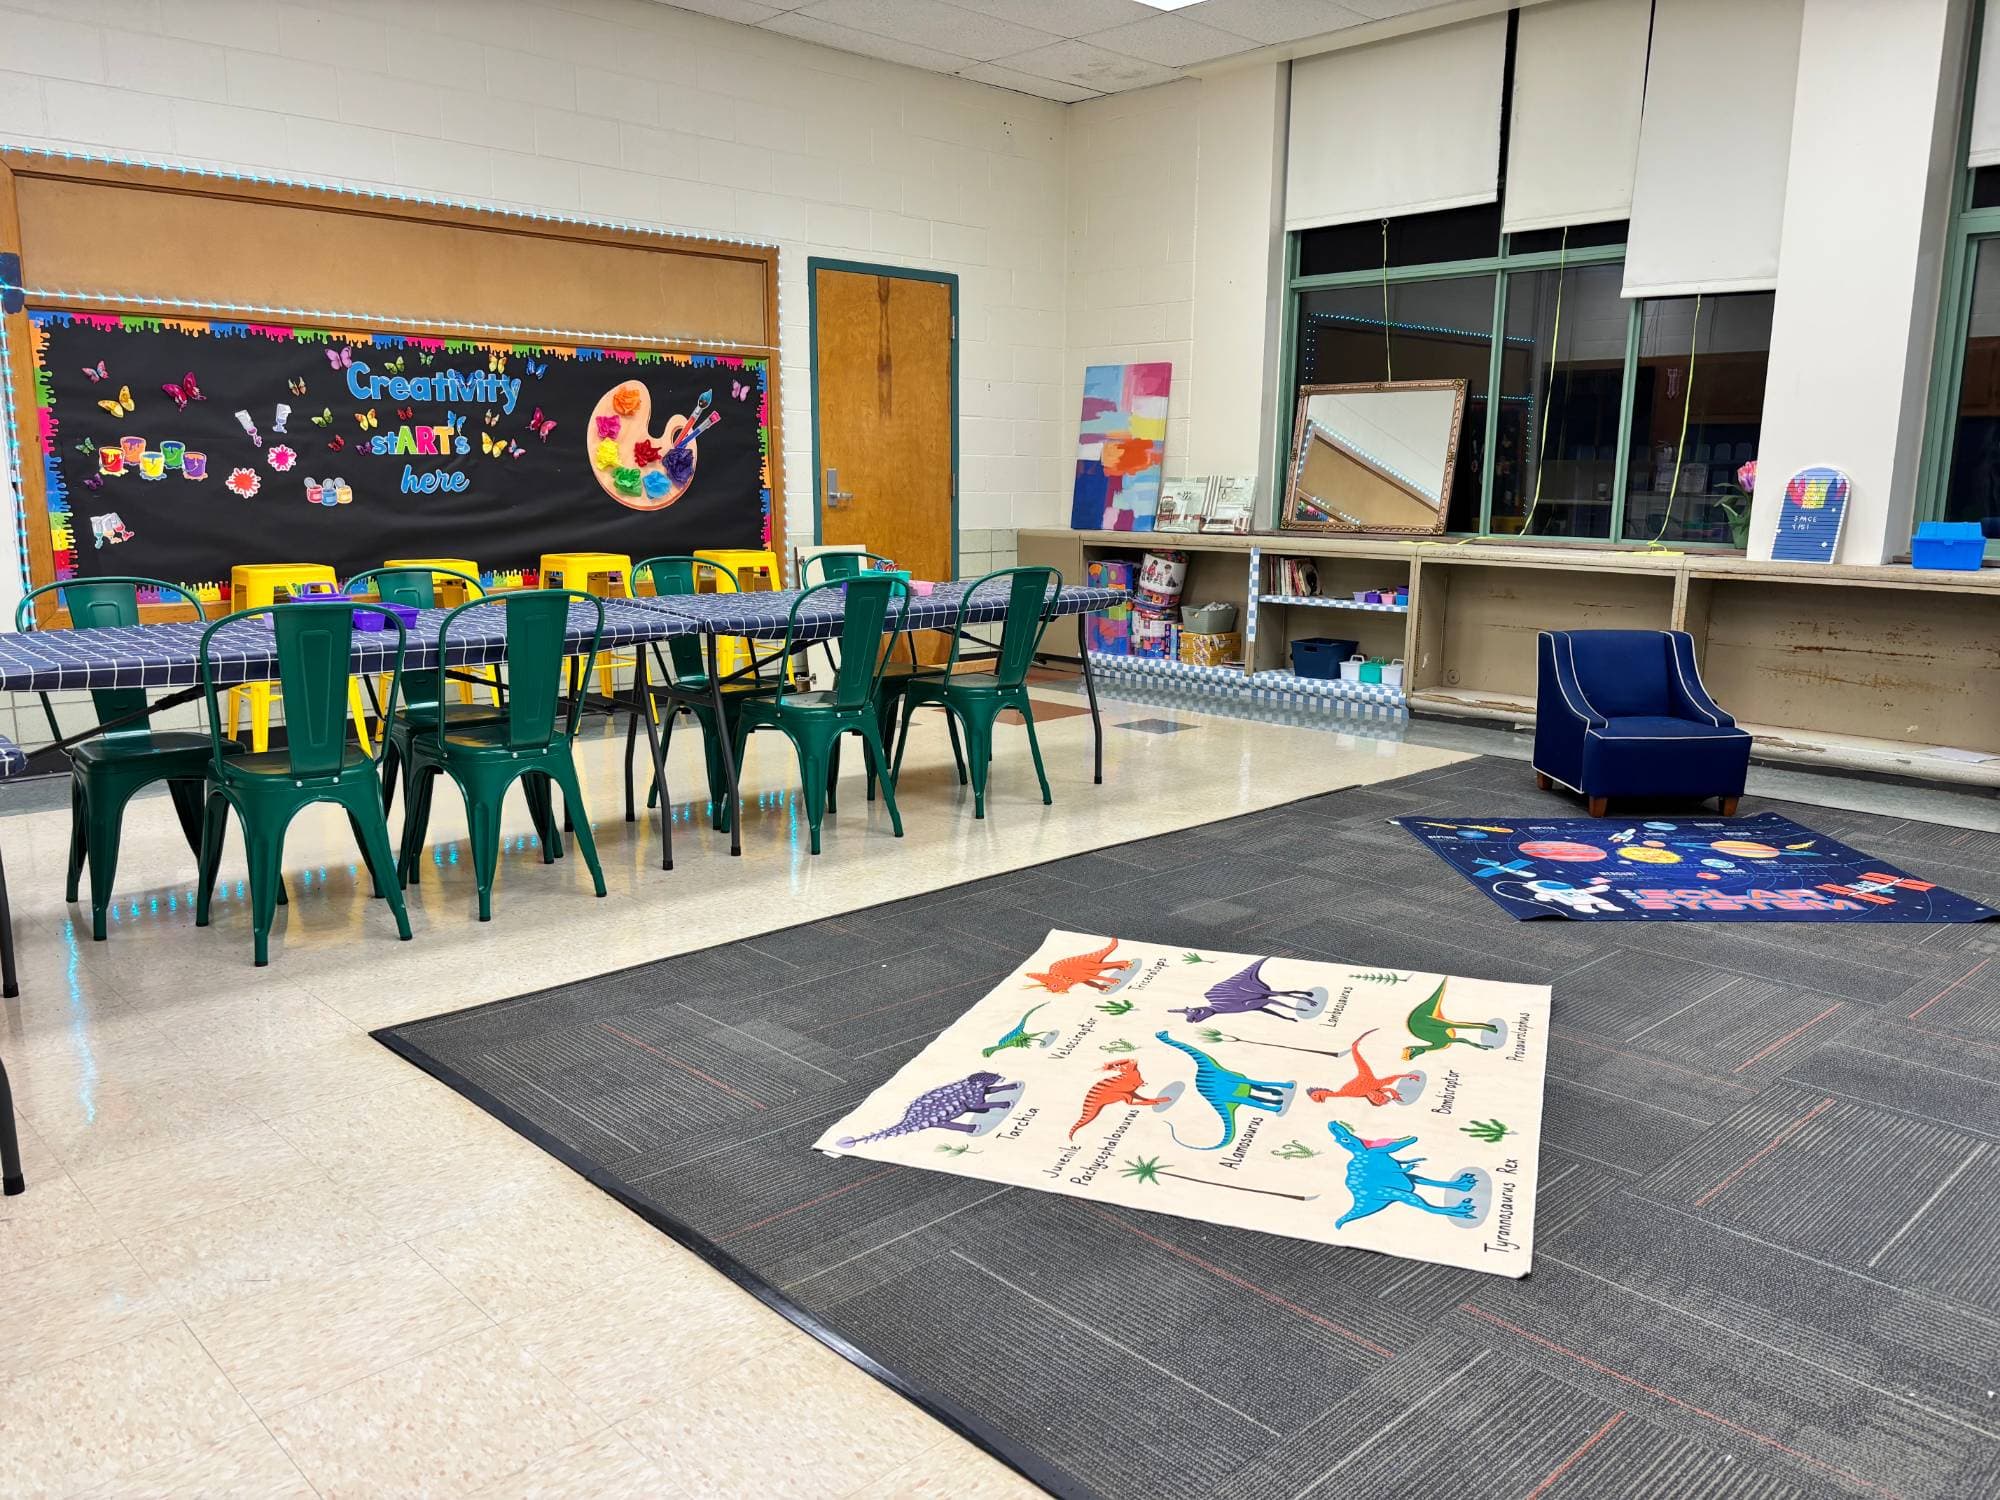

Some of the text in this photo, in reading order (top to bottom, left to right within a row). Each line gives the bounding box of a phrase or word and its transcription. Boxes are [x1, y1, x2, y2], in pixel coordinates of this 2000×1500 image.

[346, 361, 522, 415] Creativity
[401, 463, 471, 494] here
[1127, 957, 1170, 991] Triceratops
[1319, 986, 1354, 1028] Lambeosaurus
[1048, 1017, 1098, 1060] Velociraptor
[1431, 1068, 1464, 1115] Bambiraptor
[995, 1106, 1041, 1140] Tarchia
[1218, 1116, 1264, 1170] Alamosaurus
[1042, 1145, 1082, 1179] Juvenile
[1069, 1108, 1141, 1186] Pachycephalosaurus
[1484, 1158, 1520, 1253] Tyrannosaurus Rex
